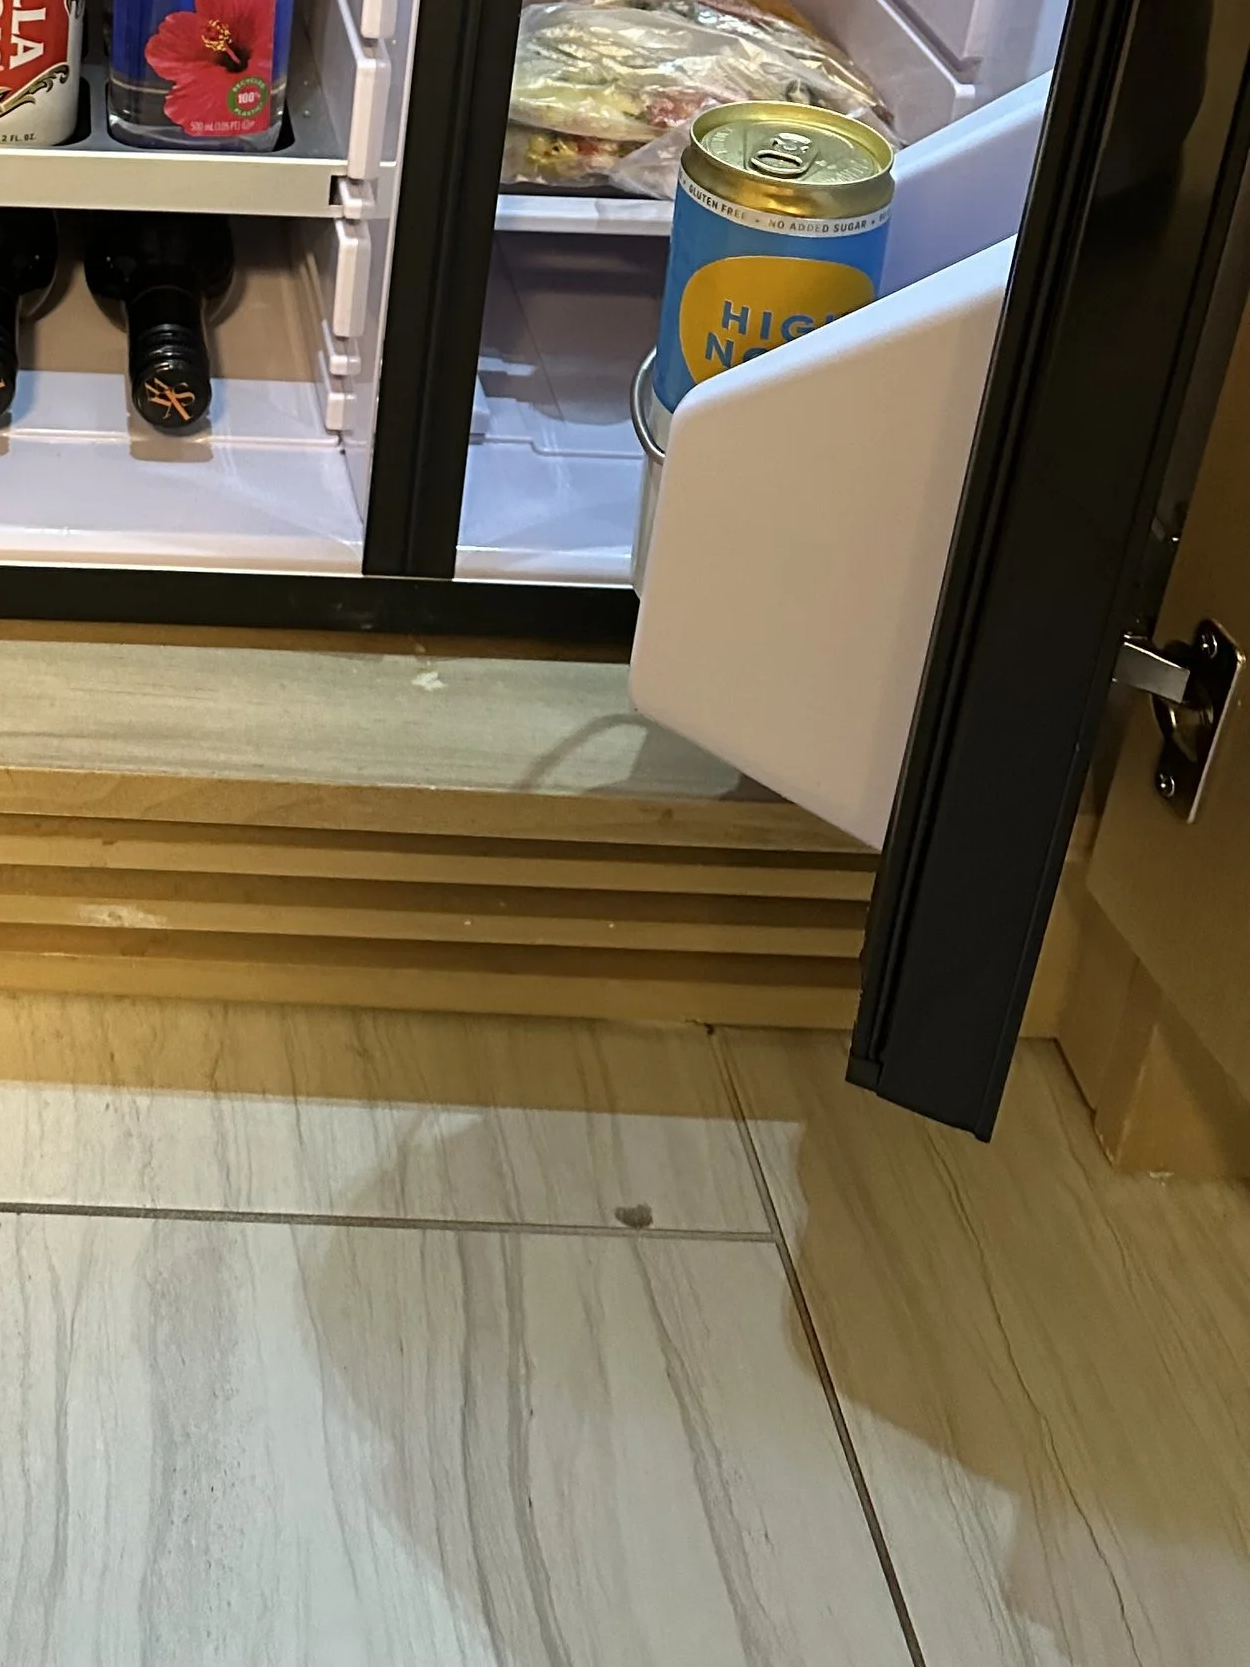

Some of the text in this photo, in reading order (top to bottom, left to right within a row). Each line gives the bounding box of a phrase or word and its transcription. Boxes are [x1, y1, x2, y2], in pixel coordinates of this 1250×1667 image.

[688, 184, 867, 234] GLUTEN FREE NO ADDED SUGAR
